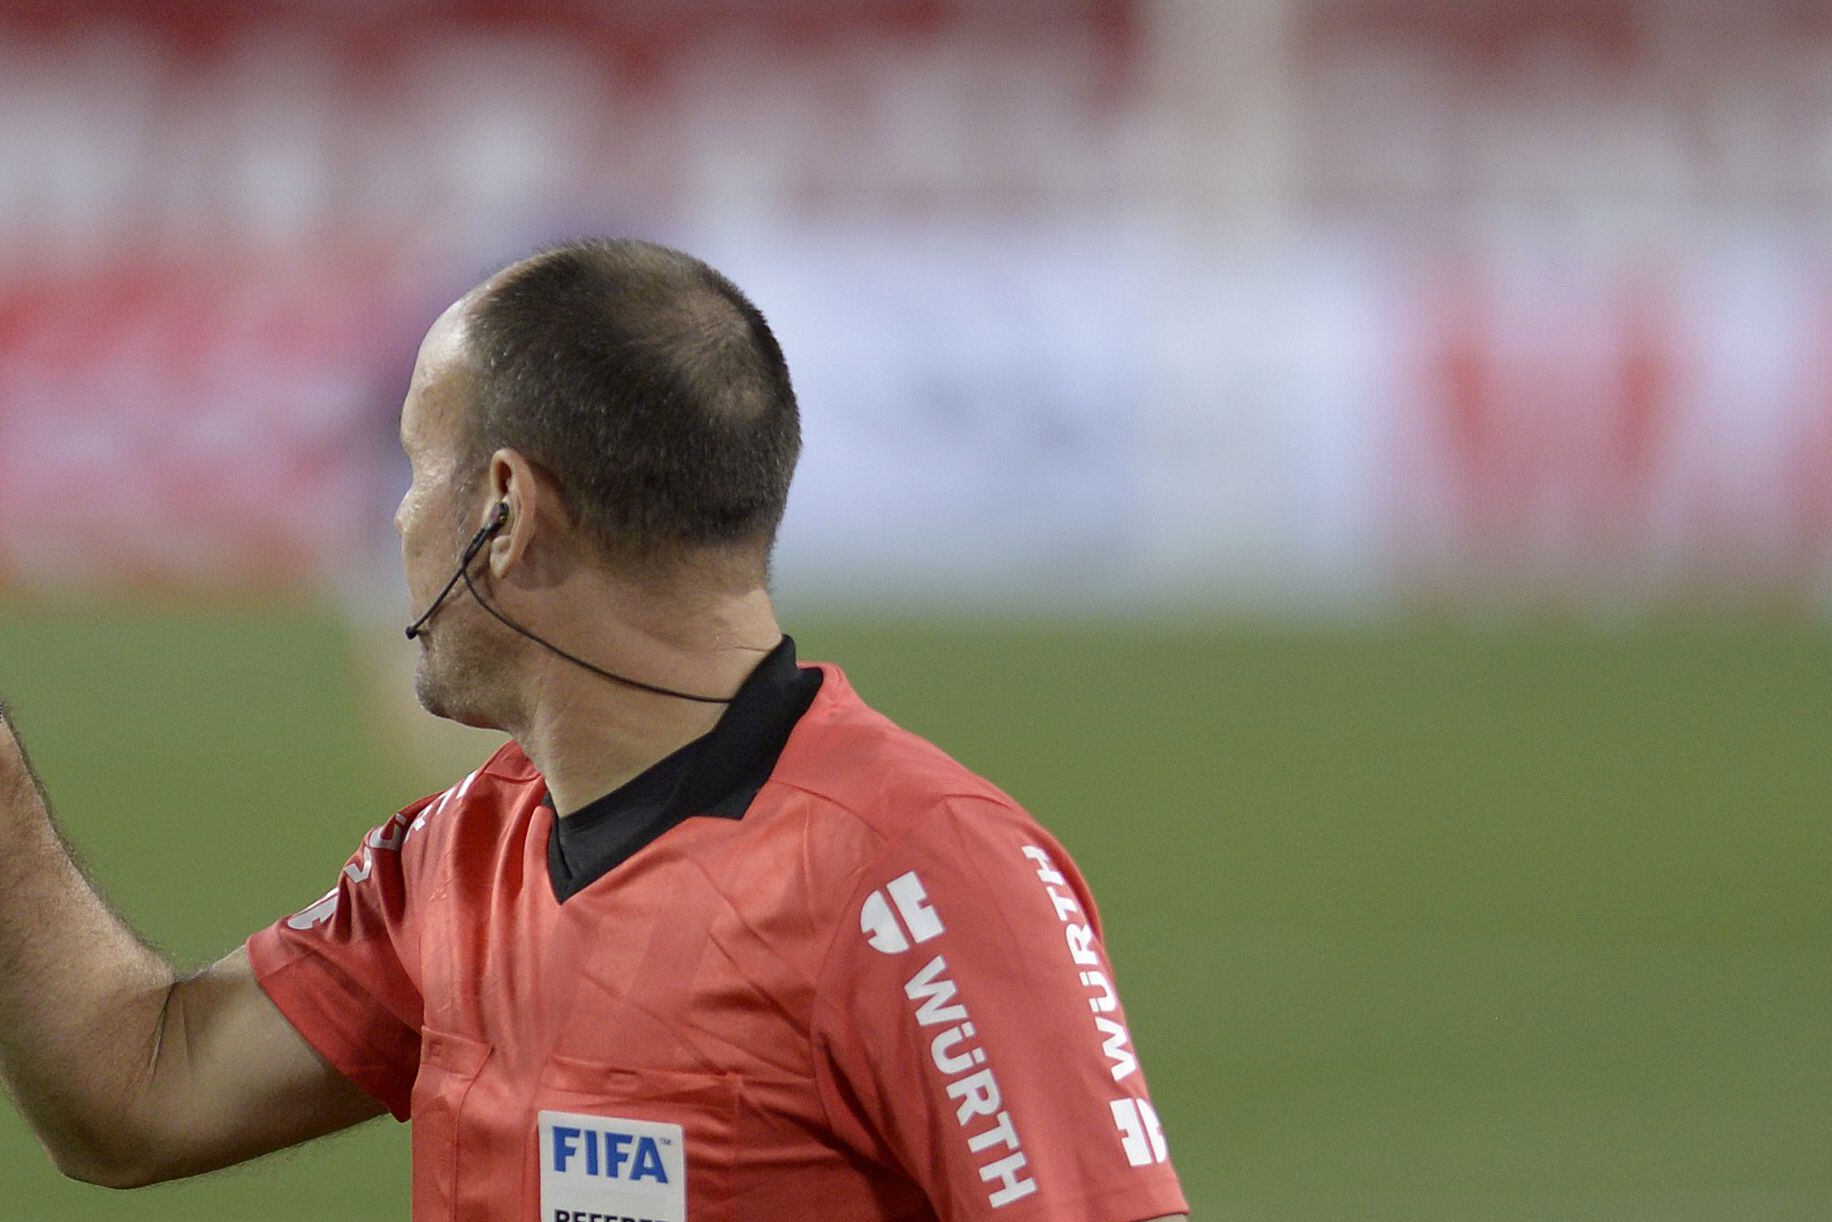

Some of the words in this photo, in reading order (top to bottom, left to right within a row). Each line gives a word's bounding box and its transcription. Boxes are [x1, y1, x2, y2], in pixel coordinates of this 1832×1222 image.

[904, 955, 1037, 1209] WÜRTH
[1022, 845, 1136, 1082] WÜRTH
[552, 1126, 668, 1184] FIFA
